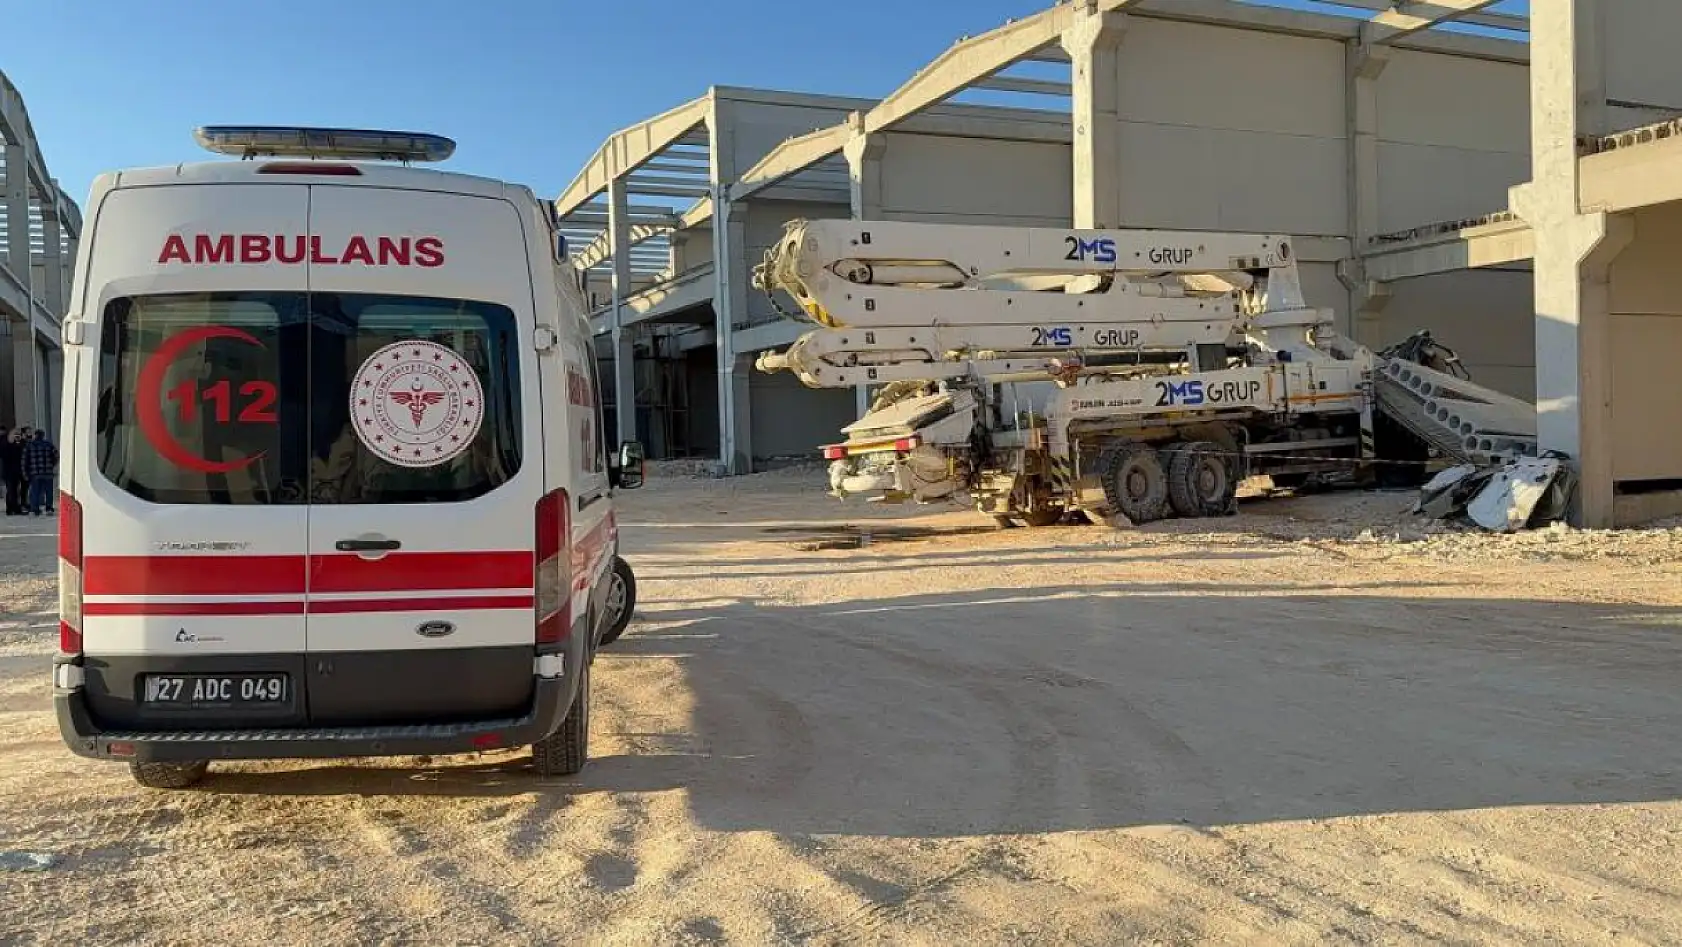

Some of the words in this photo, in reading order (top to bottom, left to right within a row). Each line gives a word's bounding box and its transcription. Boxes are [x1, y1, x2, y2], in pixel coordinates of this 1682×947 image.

[158, 234, 446, 267] AMBULANS
[1064, 235, 1117, 262] 2MS
[1149, 247, 1193, 265] GRUP
[1031, 326, 1072, 346] 2MS
[1094, 329, 1139, 346] GRUP
[166, 379, 279, 422] 112
[1155, 380, 1204, 407] 2MS
[1206, 380, 1261, 403] GRUP
[158, 678, 184, 700] 27
[193, 678, 232, 700] ADC
[241, 678, 282, 700] 049
